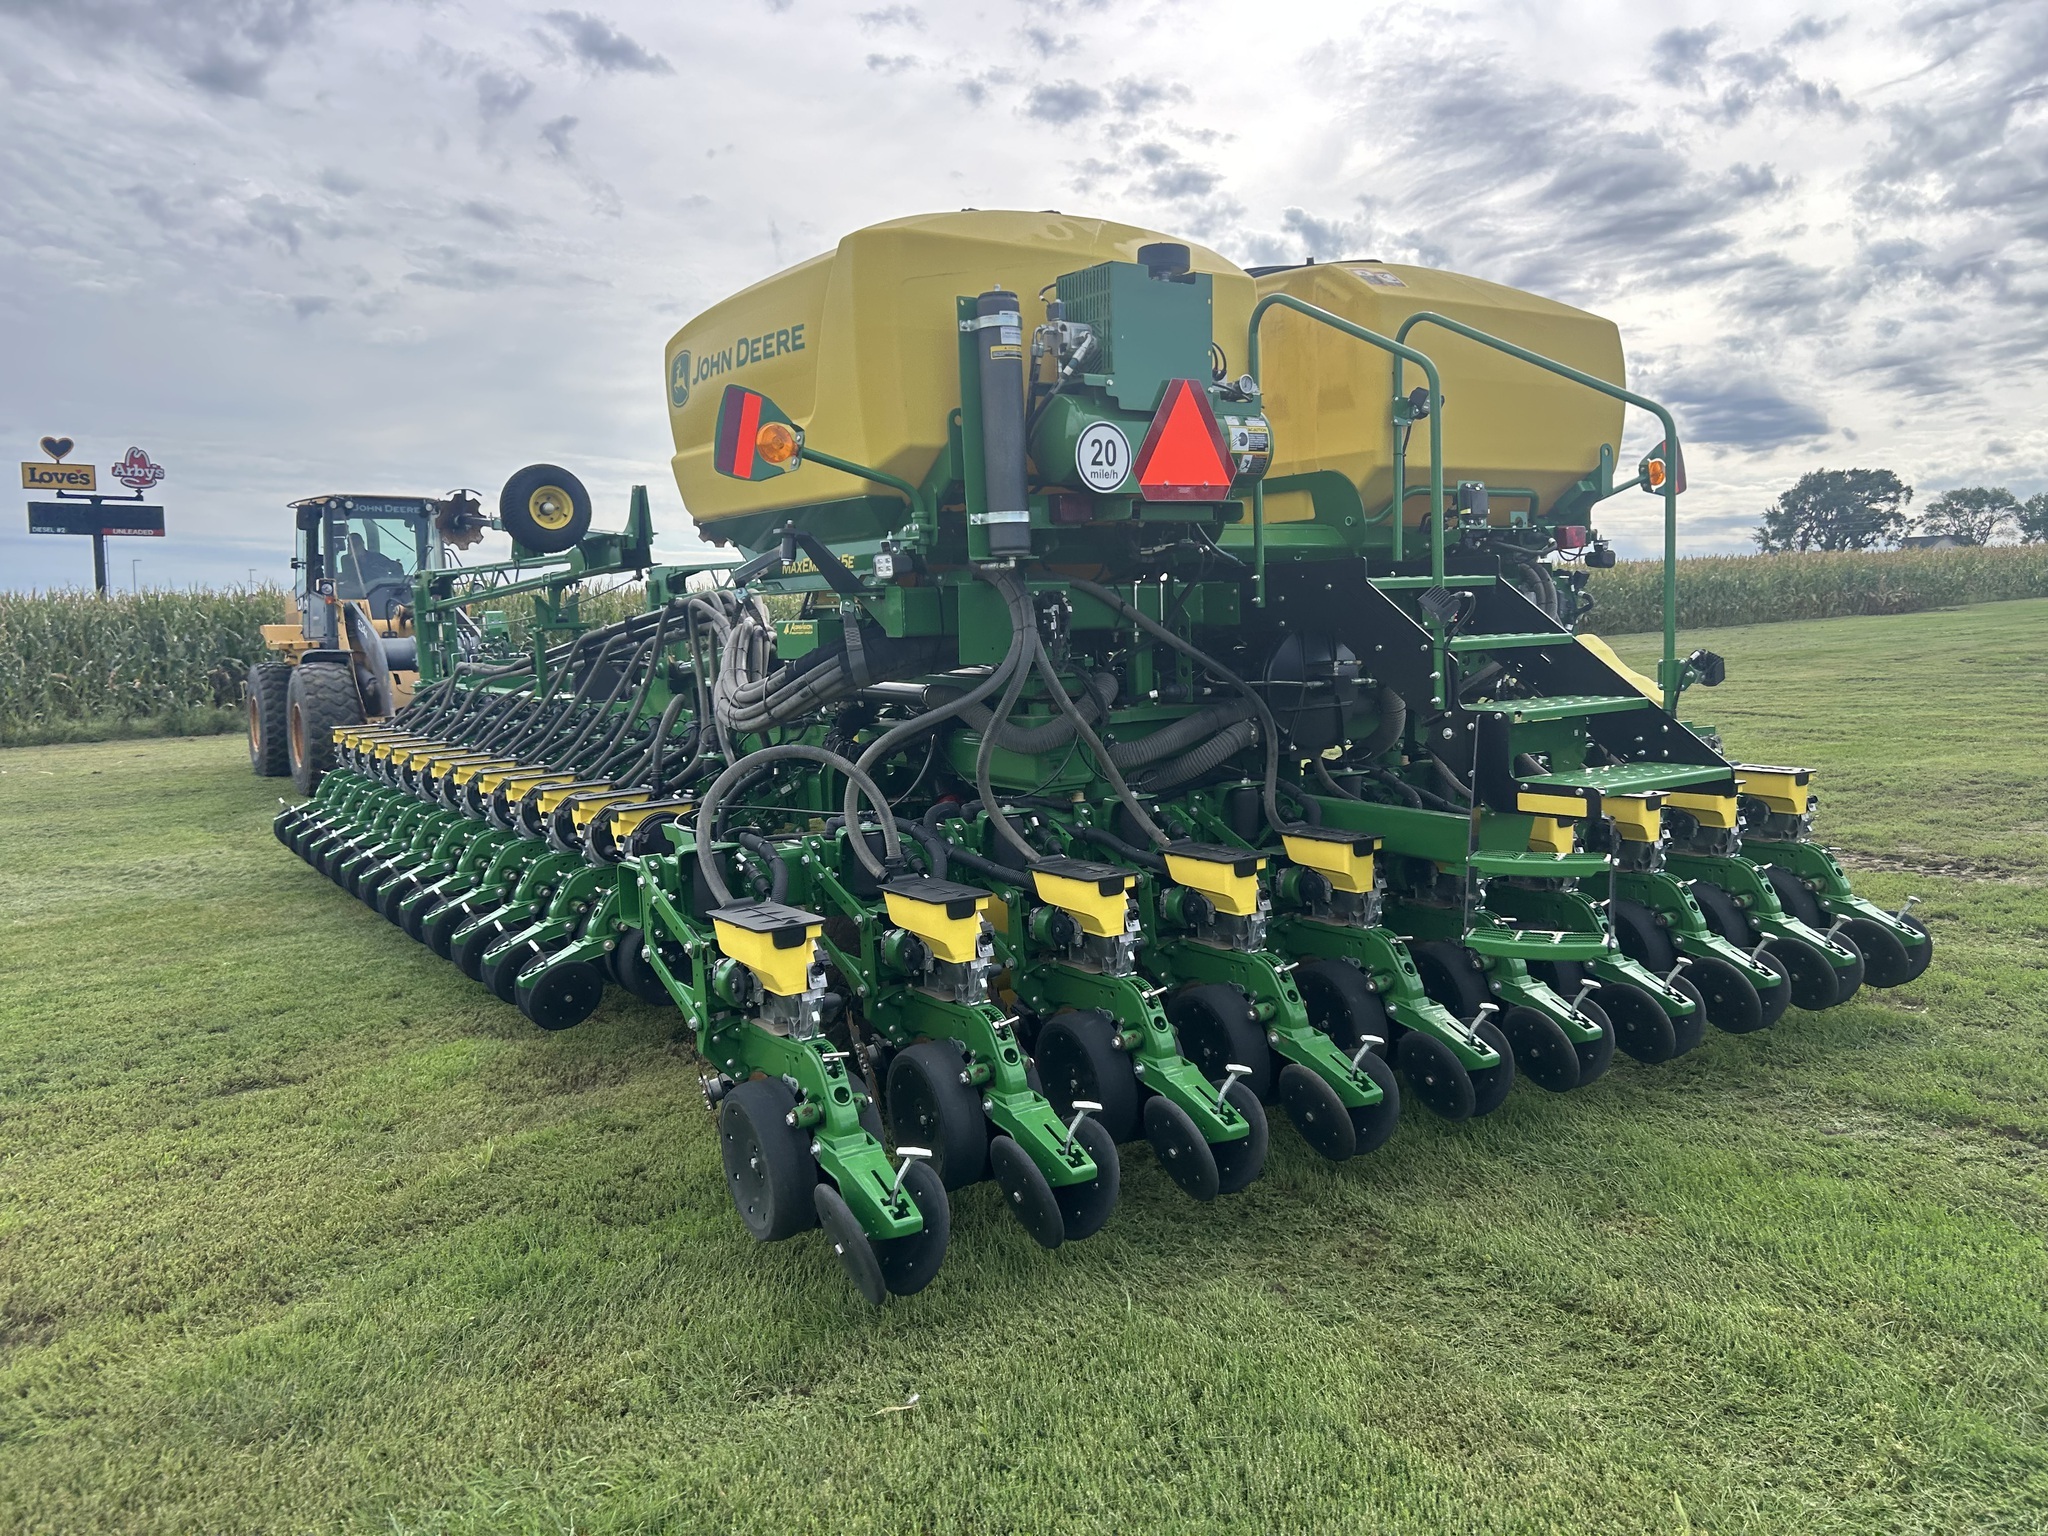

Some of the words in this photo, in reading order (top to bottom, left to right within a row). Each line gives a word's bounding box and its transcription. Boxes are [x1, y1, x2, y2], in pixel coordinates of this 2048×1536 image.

[692, 347, 732, 386] JOHN
[736, 323, 806, 368] DEERE
[1091, 438, 1117, 467] 20
[113, 463, 165, 481] Arby's
[1090, 469, 1118, 479] mile/h
[353, 503, 382, 512] JOHN
[384, 504, 421, 514] DEERE
[112, 528, 154, 536] UNLEADED
